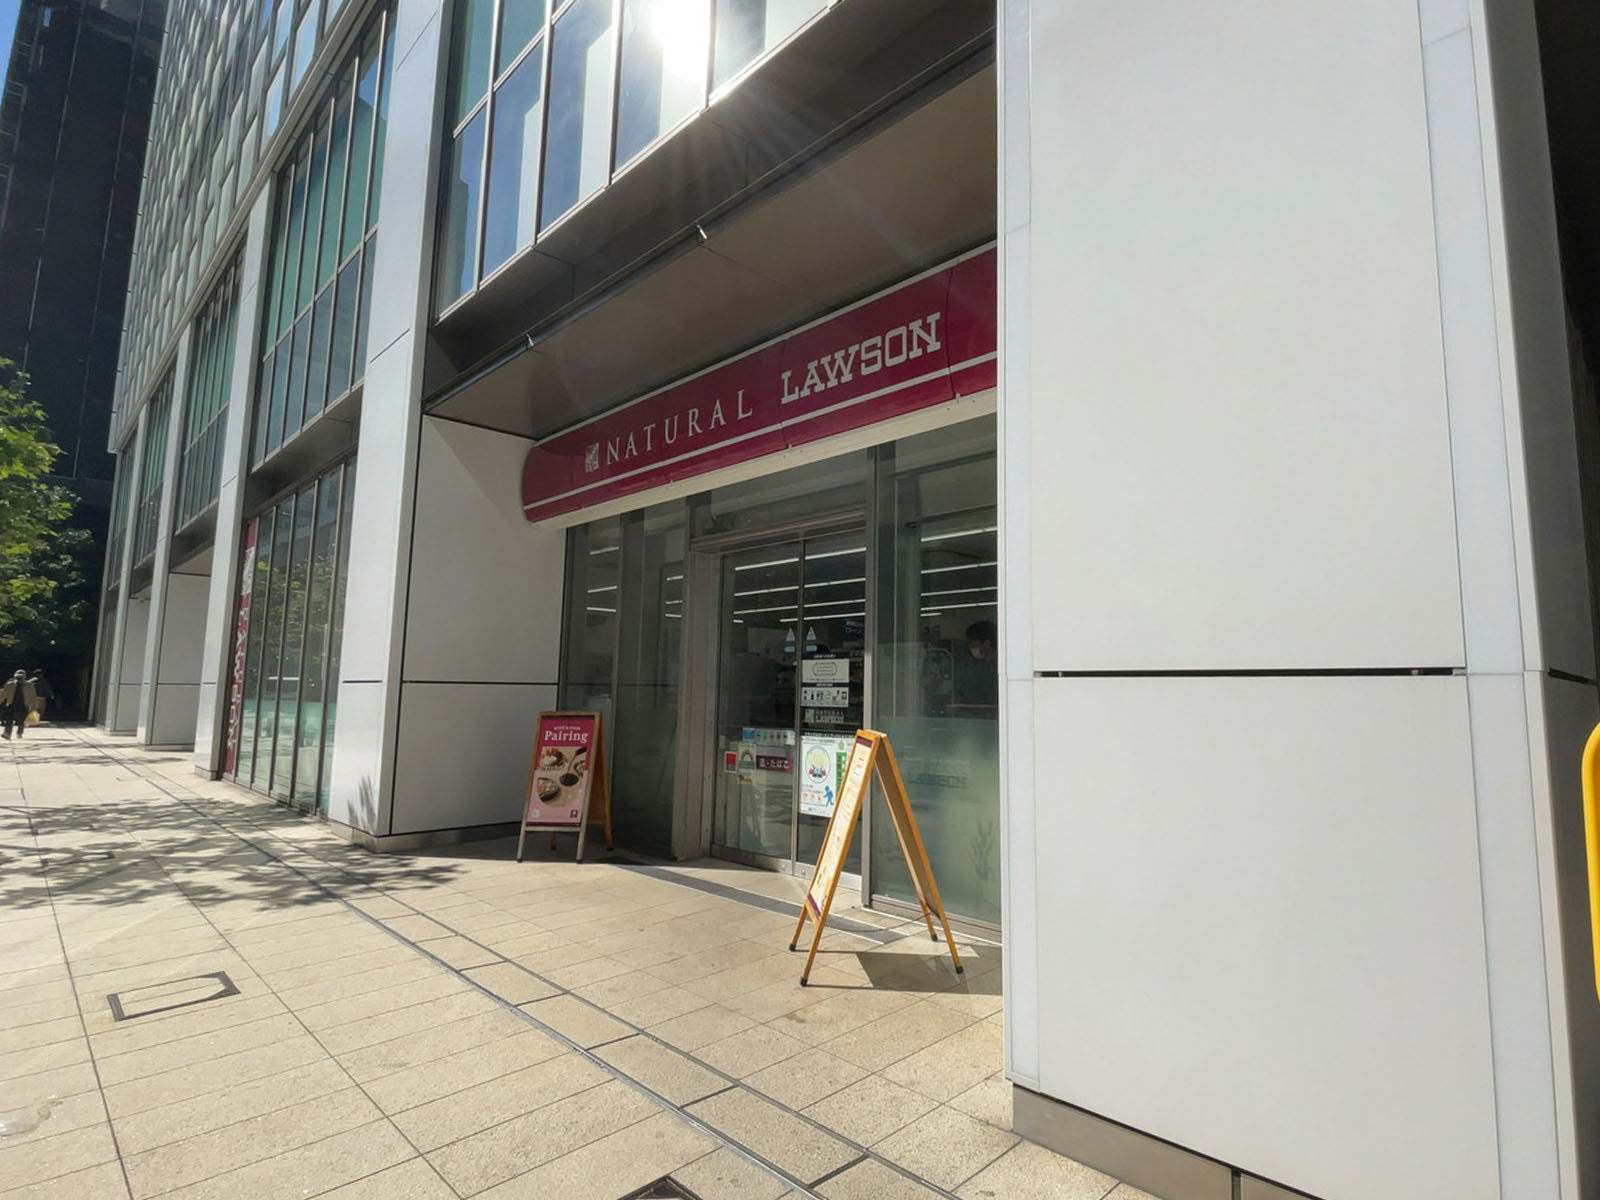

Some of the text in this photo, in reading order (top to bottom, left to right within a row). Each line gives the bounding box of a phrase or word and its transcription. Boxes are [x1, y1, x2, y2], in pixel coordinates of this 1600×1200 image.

[606, 312, 942, 466] NATURAL LAWSON
[544, 730, 588, 744] Pairing
